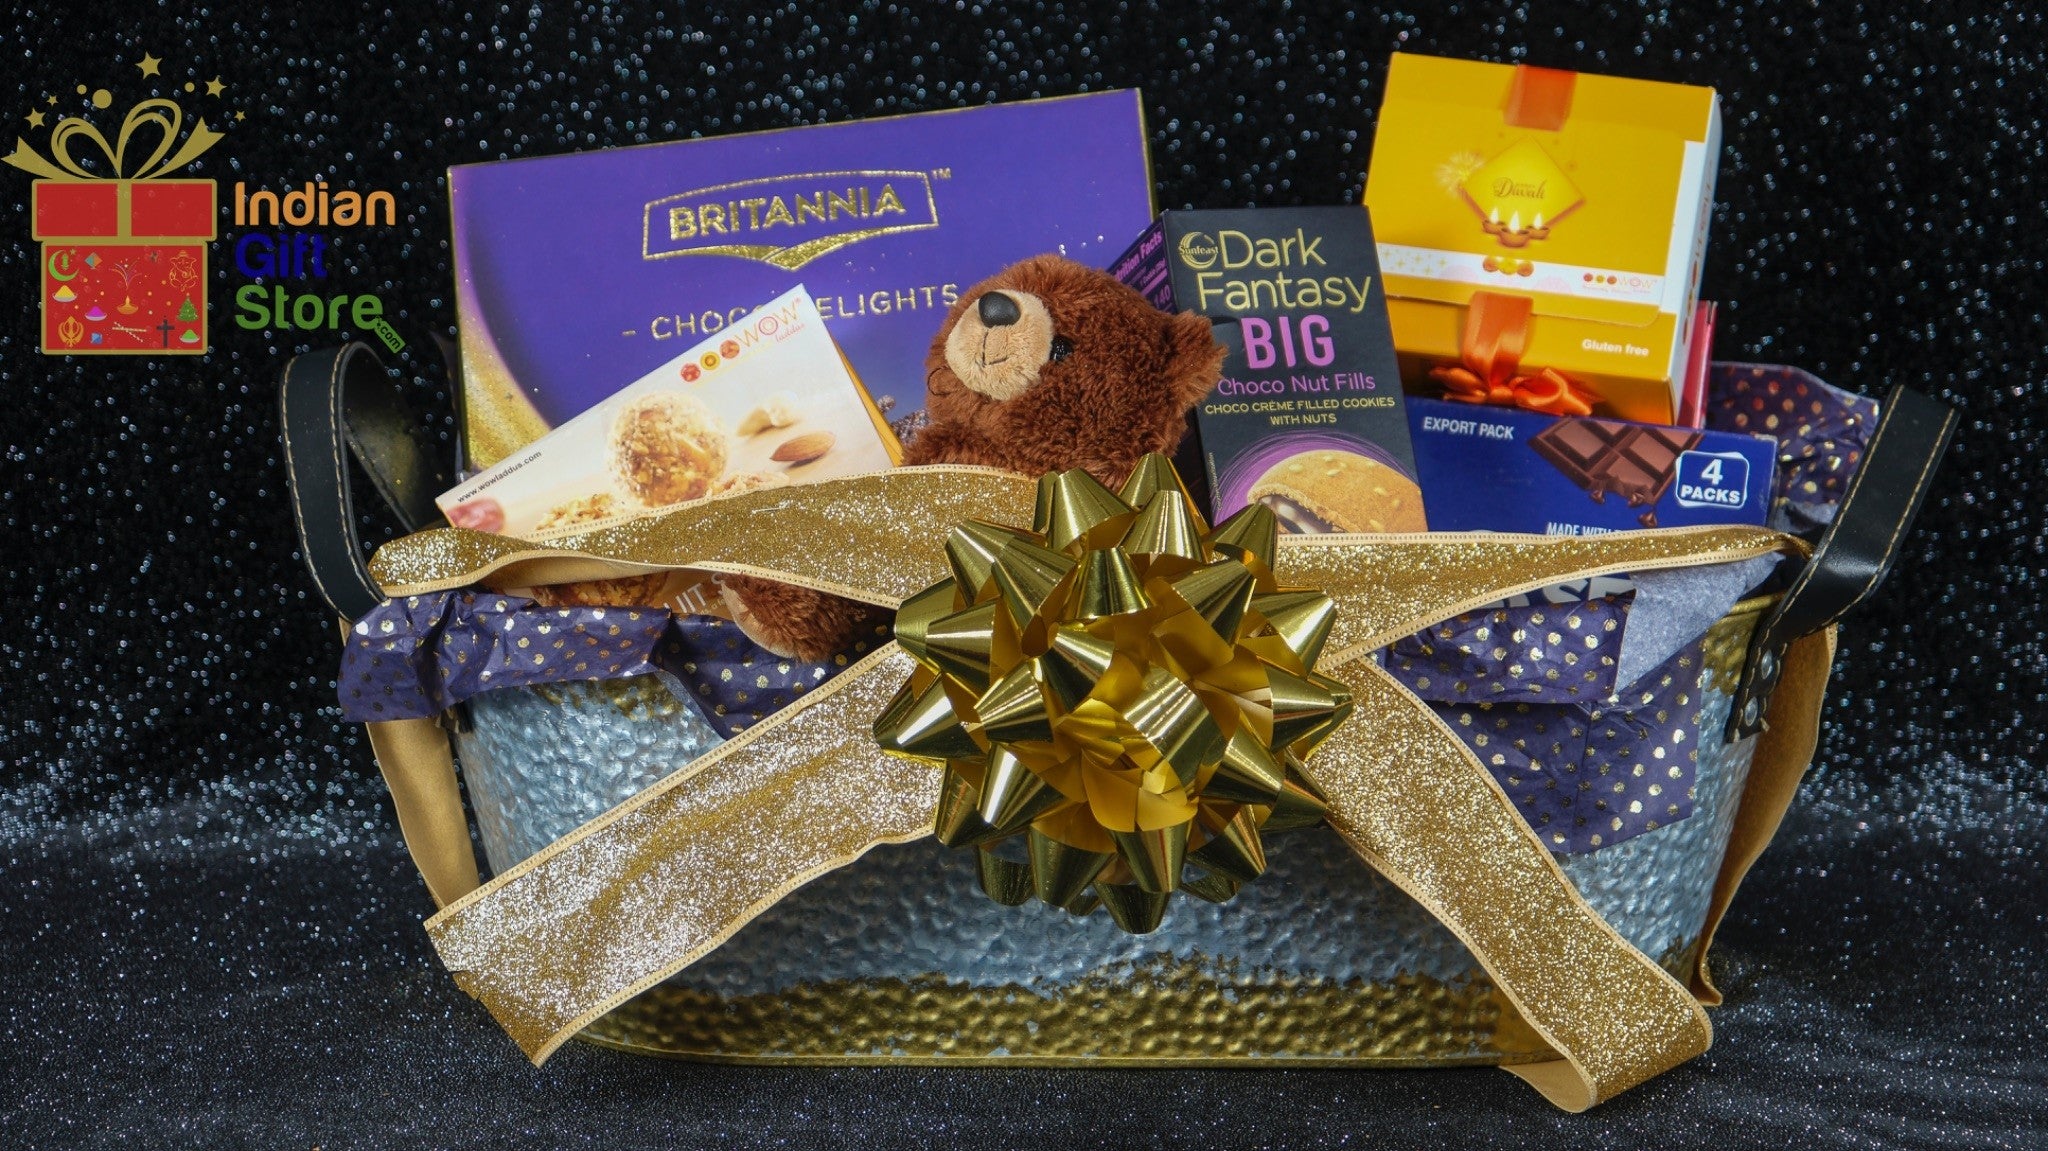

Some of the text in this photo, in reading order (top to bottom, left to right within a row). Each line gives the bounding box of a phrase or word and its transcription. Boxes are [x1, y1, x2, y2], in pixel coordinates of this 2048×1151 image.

[669, 184, 906, 240] BRITANNIA
[1178, 245, 1219, 256] Sunfeast
[1219, 228, 1327, 270] Dark
[1197, 271, 1371, 313] Fantasy
[651, 283, 958, 340] CHOC ELIGHTS
[1241, 315, 1335, 369] BIG
[1582, 338, 1649, 357] Gluten free
[1217, 372, 1376, 395] Choco Nut Fills
[1205, 403, 1249, 415] CHOCO
[1298, 400, 1340, 411] FILLED
[1343, 397, 1395, 408] COOKIES
[1270, 413, 1337, 426] WITH NUTS
[1423, 416, 1515, 440] EXPORT PACK
[457, 451, 542, 503] www.wowladdus.com
[1701, 458, 1723, 486] 4
[1680, 485, 1740, 505] PACKS
[1546, 521, 1580, 536] MADE
